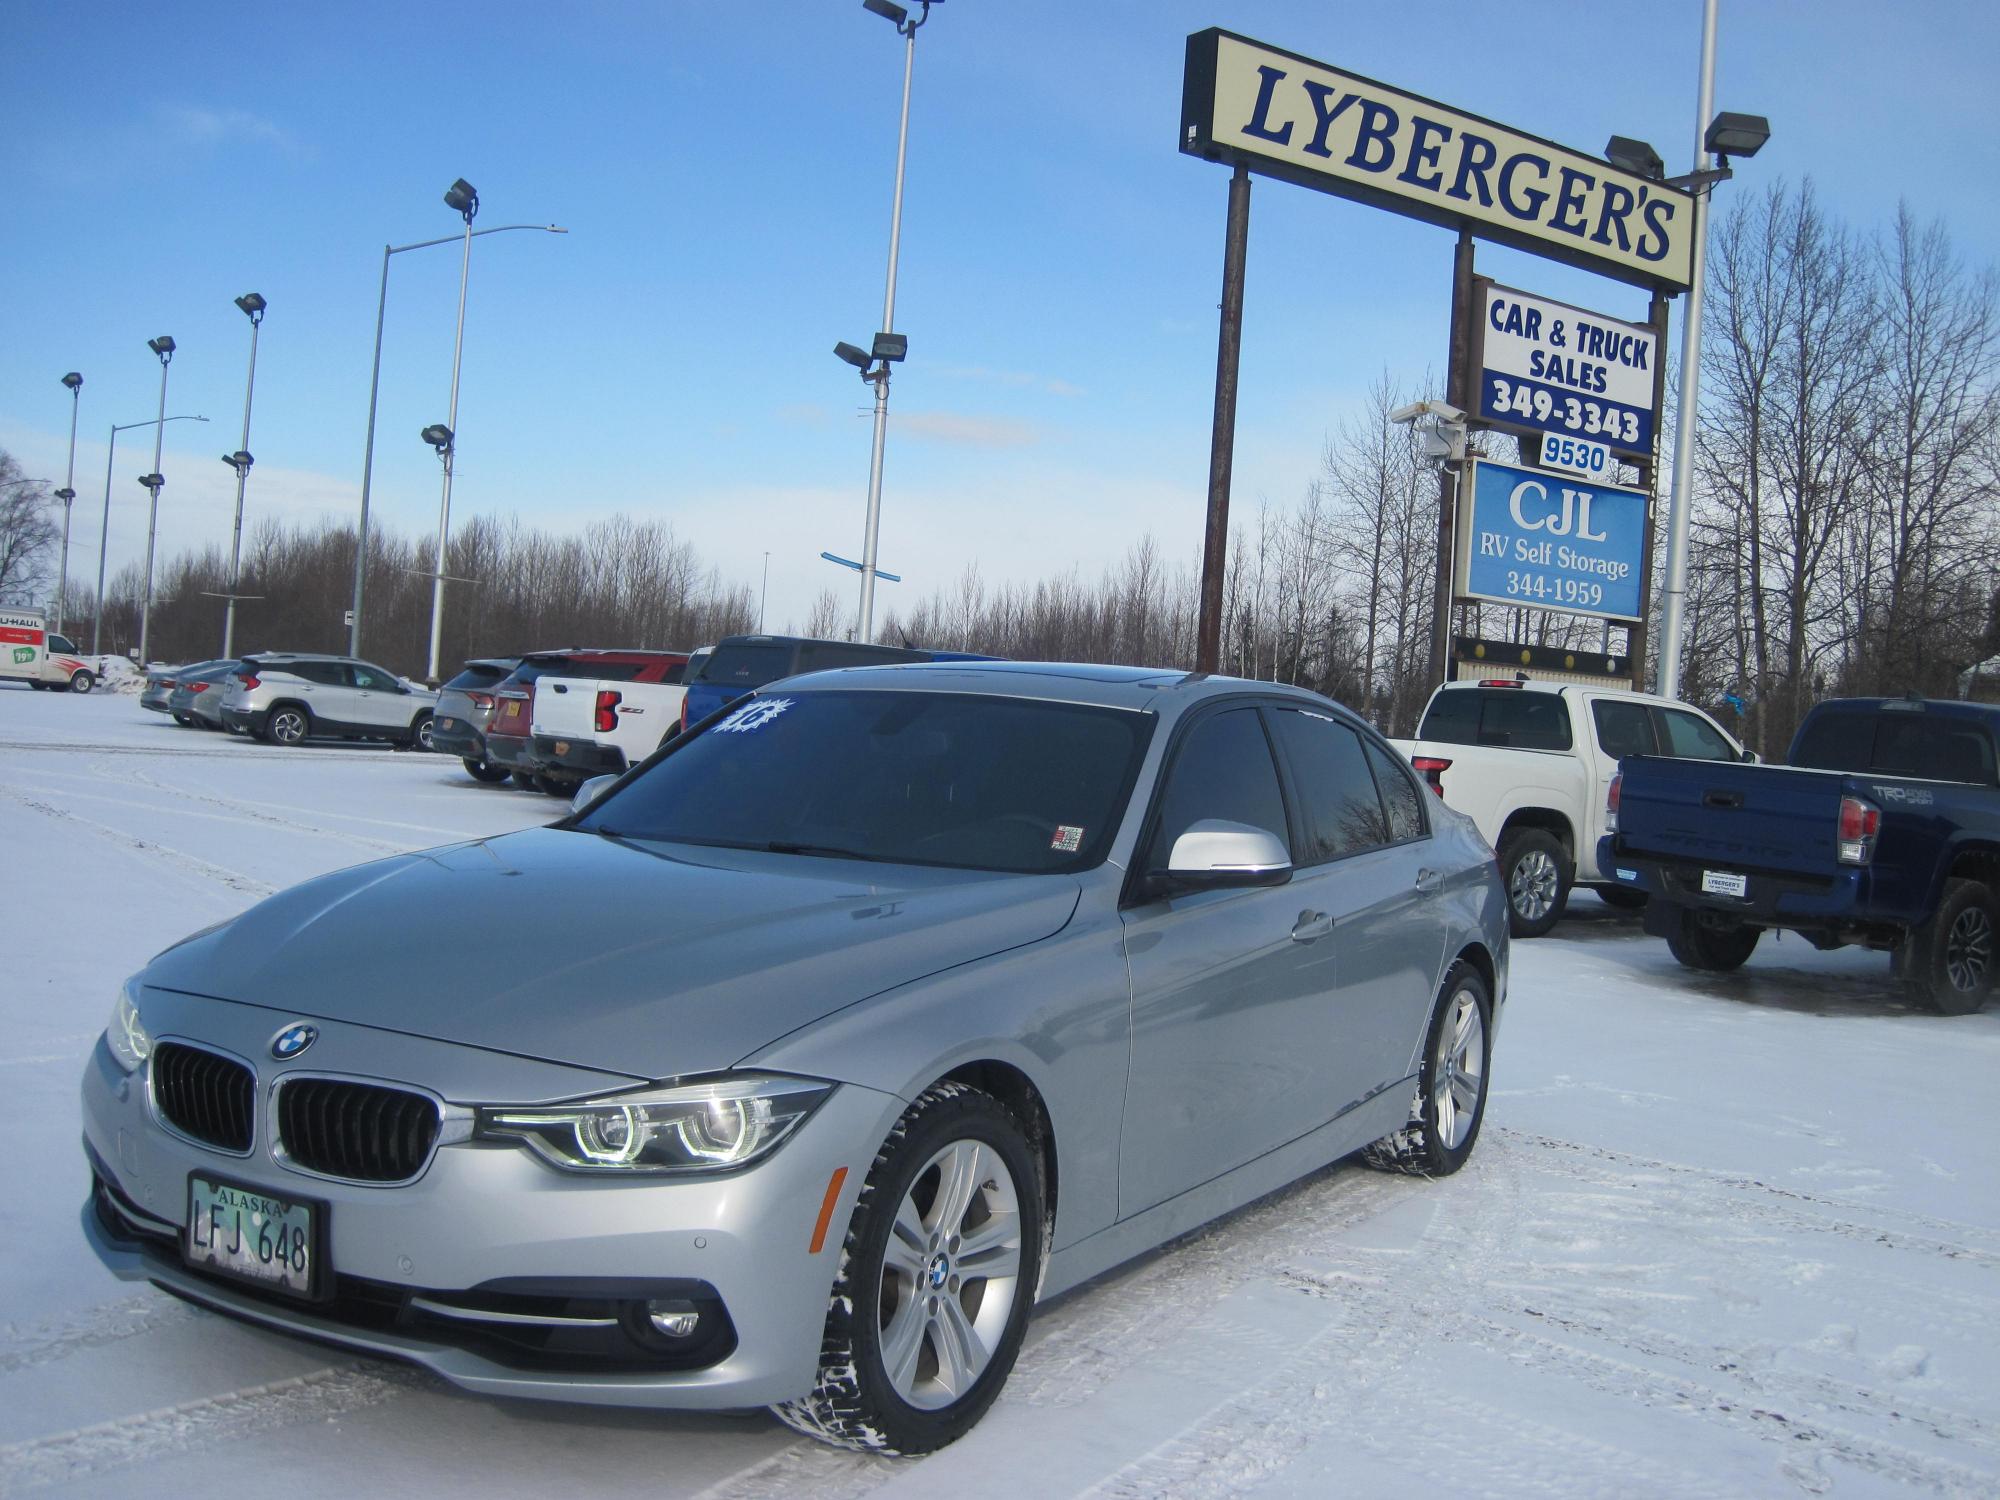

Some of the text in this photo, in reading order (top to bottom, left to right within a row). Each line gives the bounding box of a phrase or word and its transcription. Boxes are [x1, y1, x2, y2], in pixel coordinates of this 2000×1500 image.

[1240, 64, 1676, 262] LYBERGER'S
[1490, 299, 1649, 370] CAR & TRUCK
[1529, 349, 1607, 393] SALES
[1492, 379, 1639, 443] 349-3343
[1544, 436, 1605, 472] 9530
[1509, 480, 1607, 542] CJL
[1480, 532, 1629, 581] RV Self Storage
[1506, 570, 1602, 606] 344-1959
[218, 1189, 284, 1218] ALASKA
[194, 1200, 306, 1272] LFJ 648
